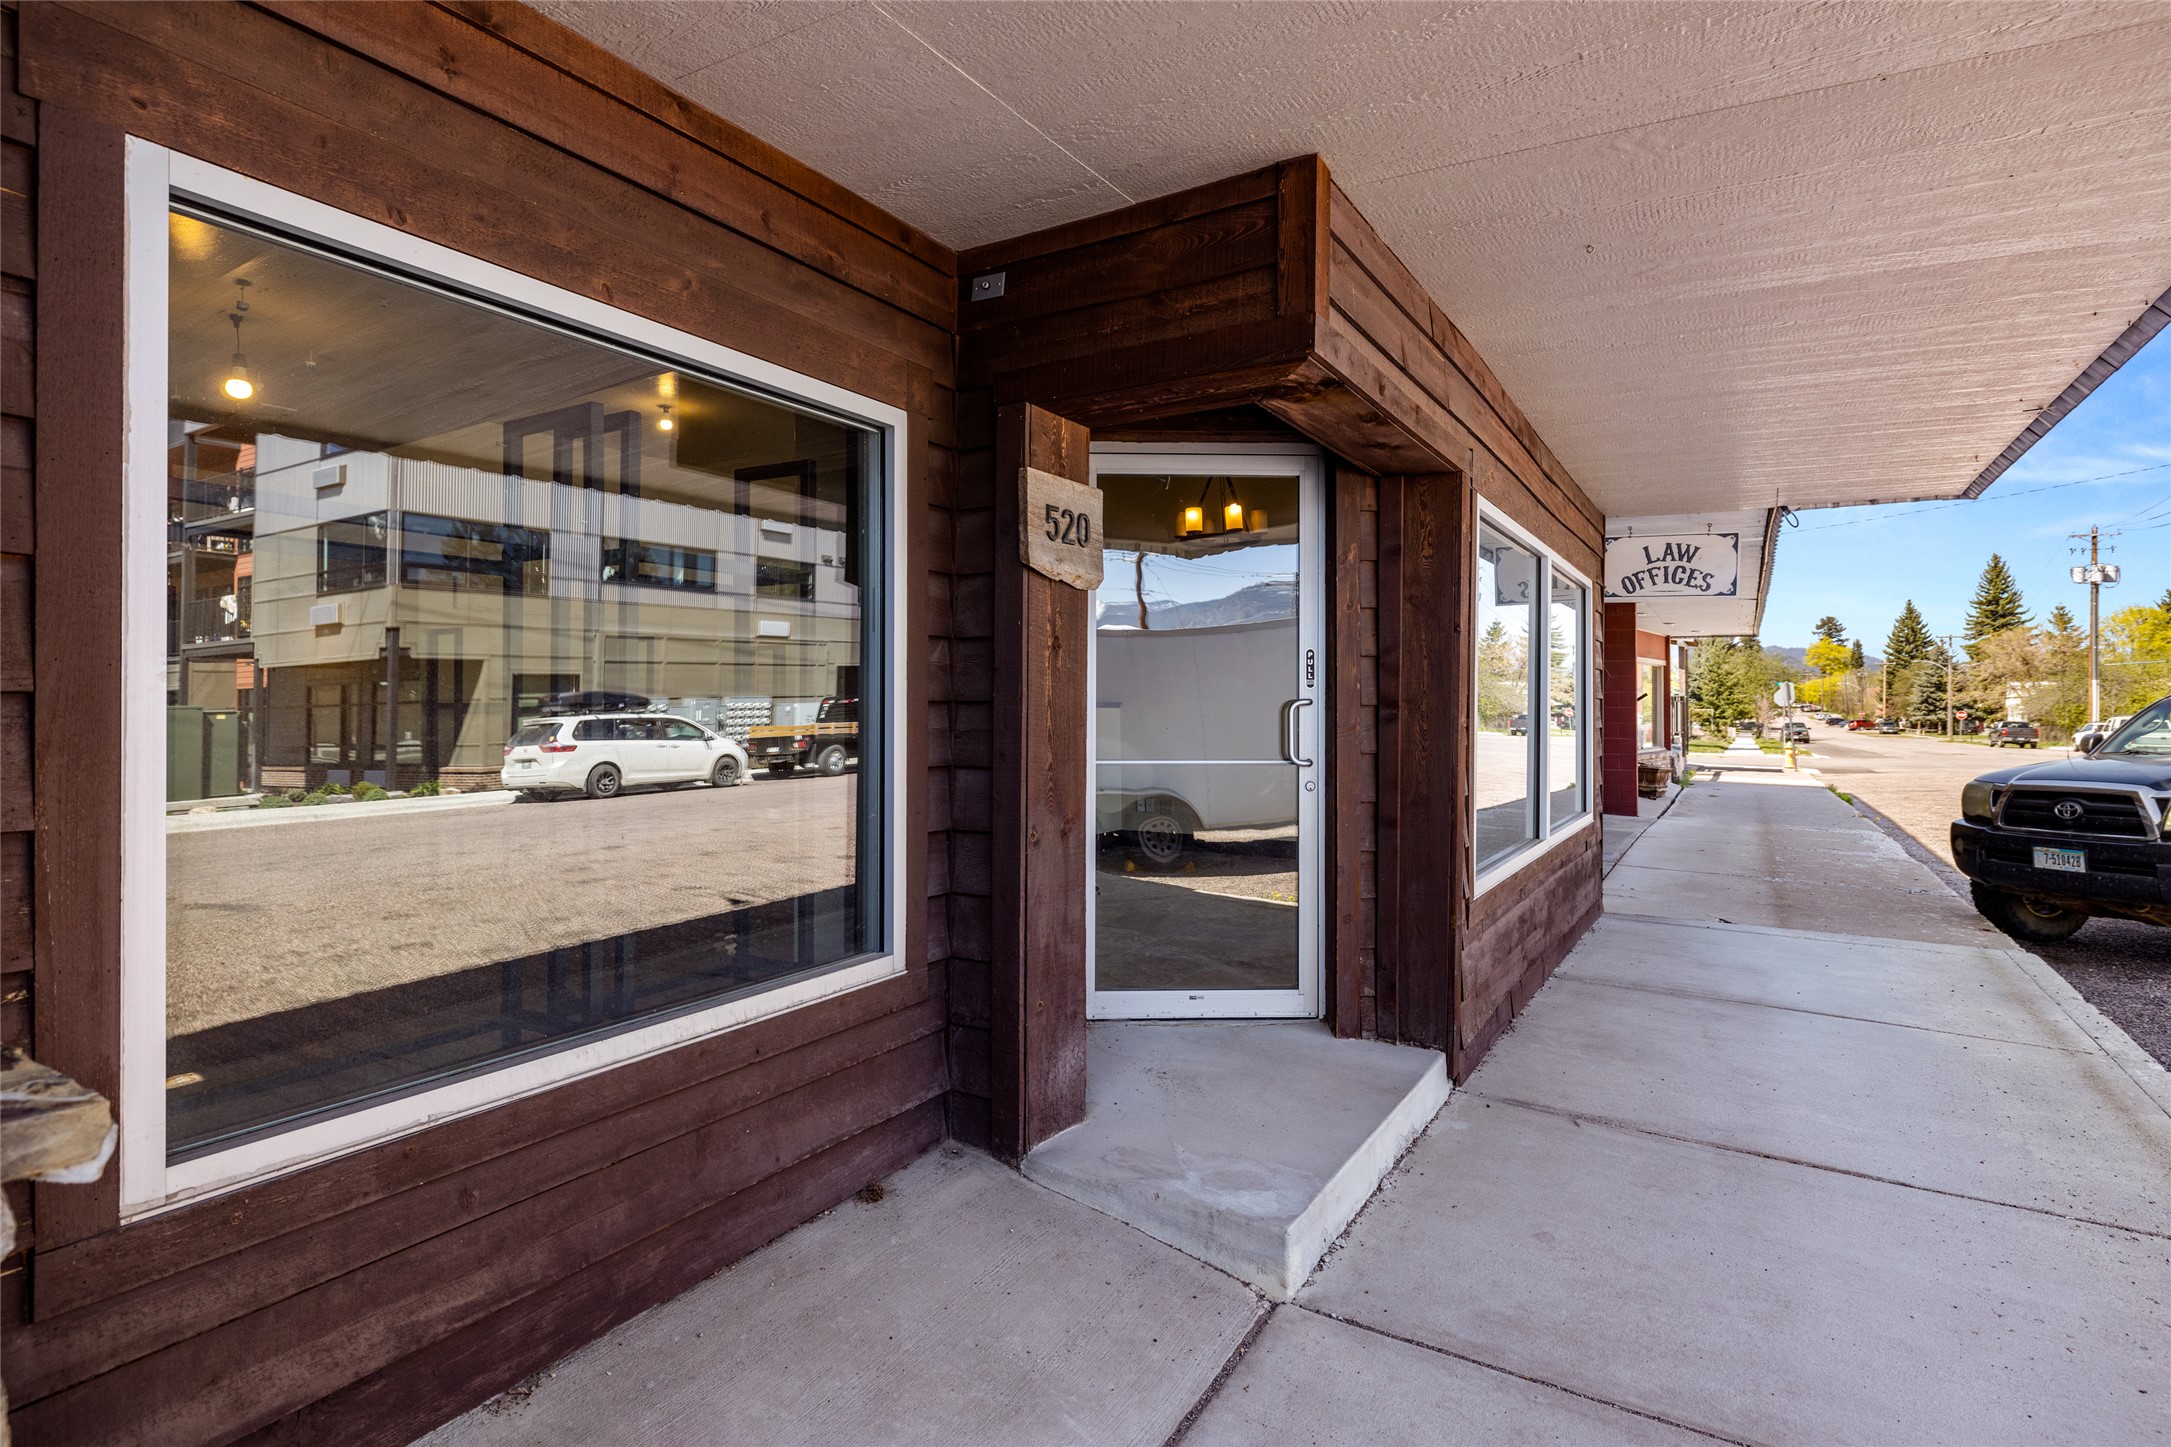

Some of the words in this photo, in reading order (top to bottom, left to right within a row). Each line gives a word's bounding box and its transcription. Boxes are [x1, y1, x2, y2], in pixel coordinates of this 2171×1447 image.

[1045, 503, 1091, 548] 520
[1642, 542, 1701, 565] LAW
[1621, 565, 1715, 595] OFFICES
